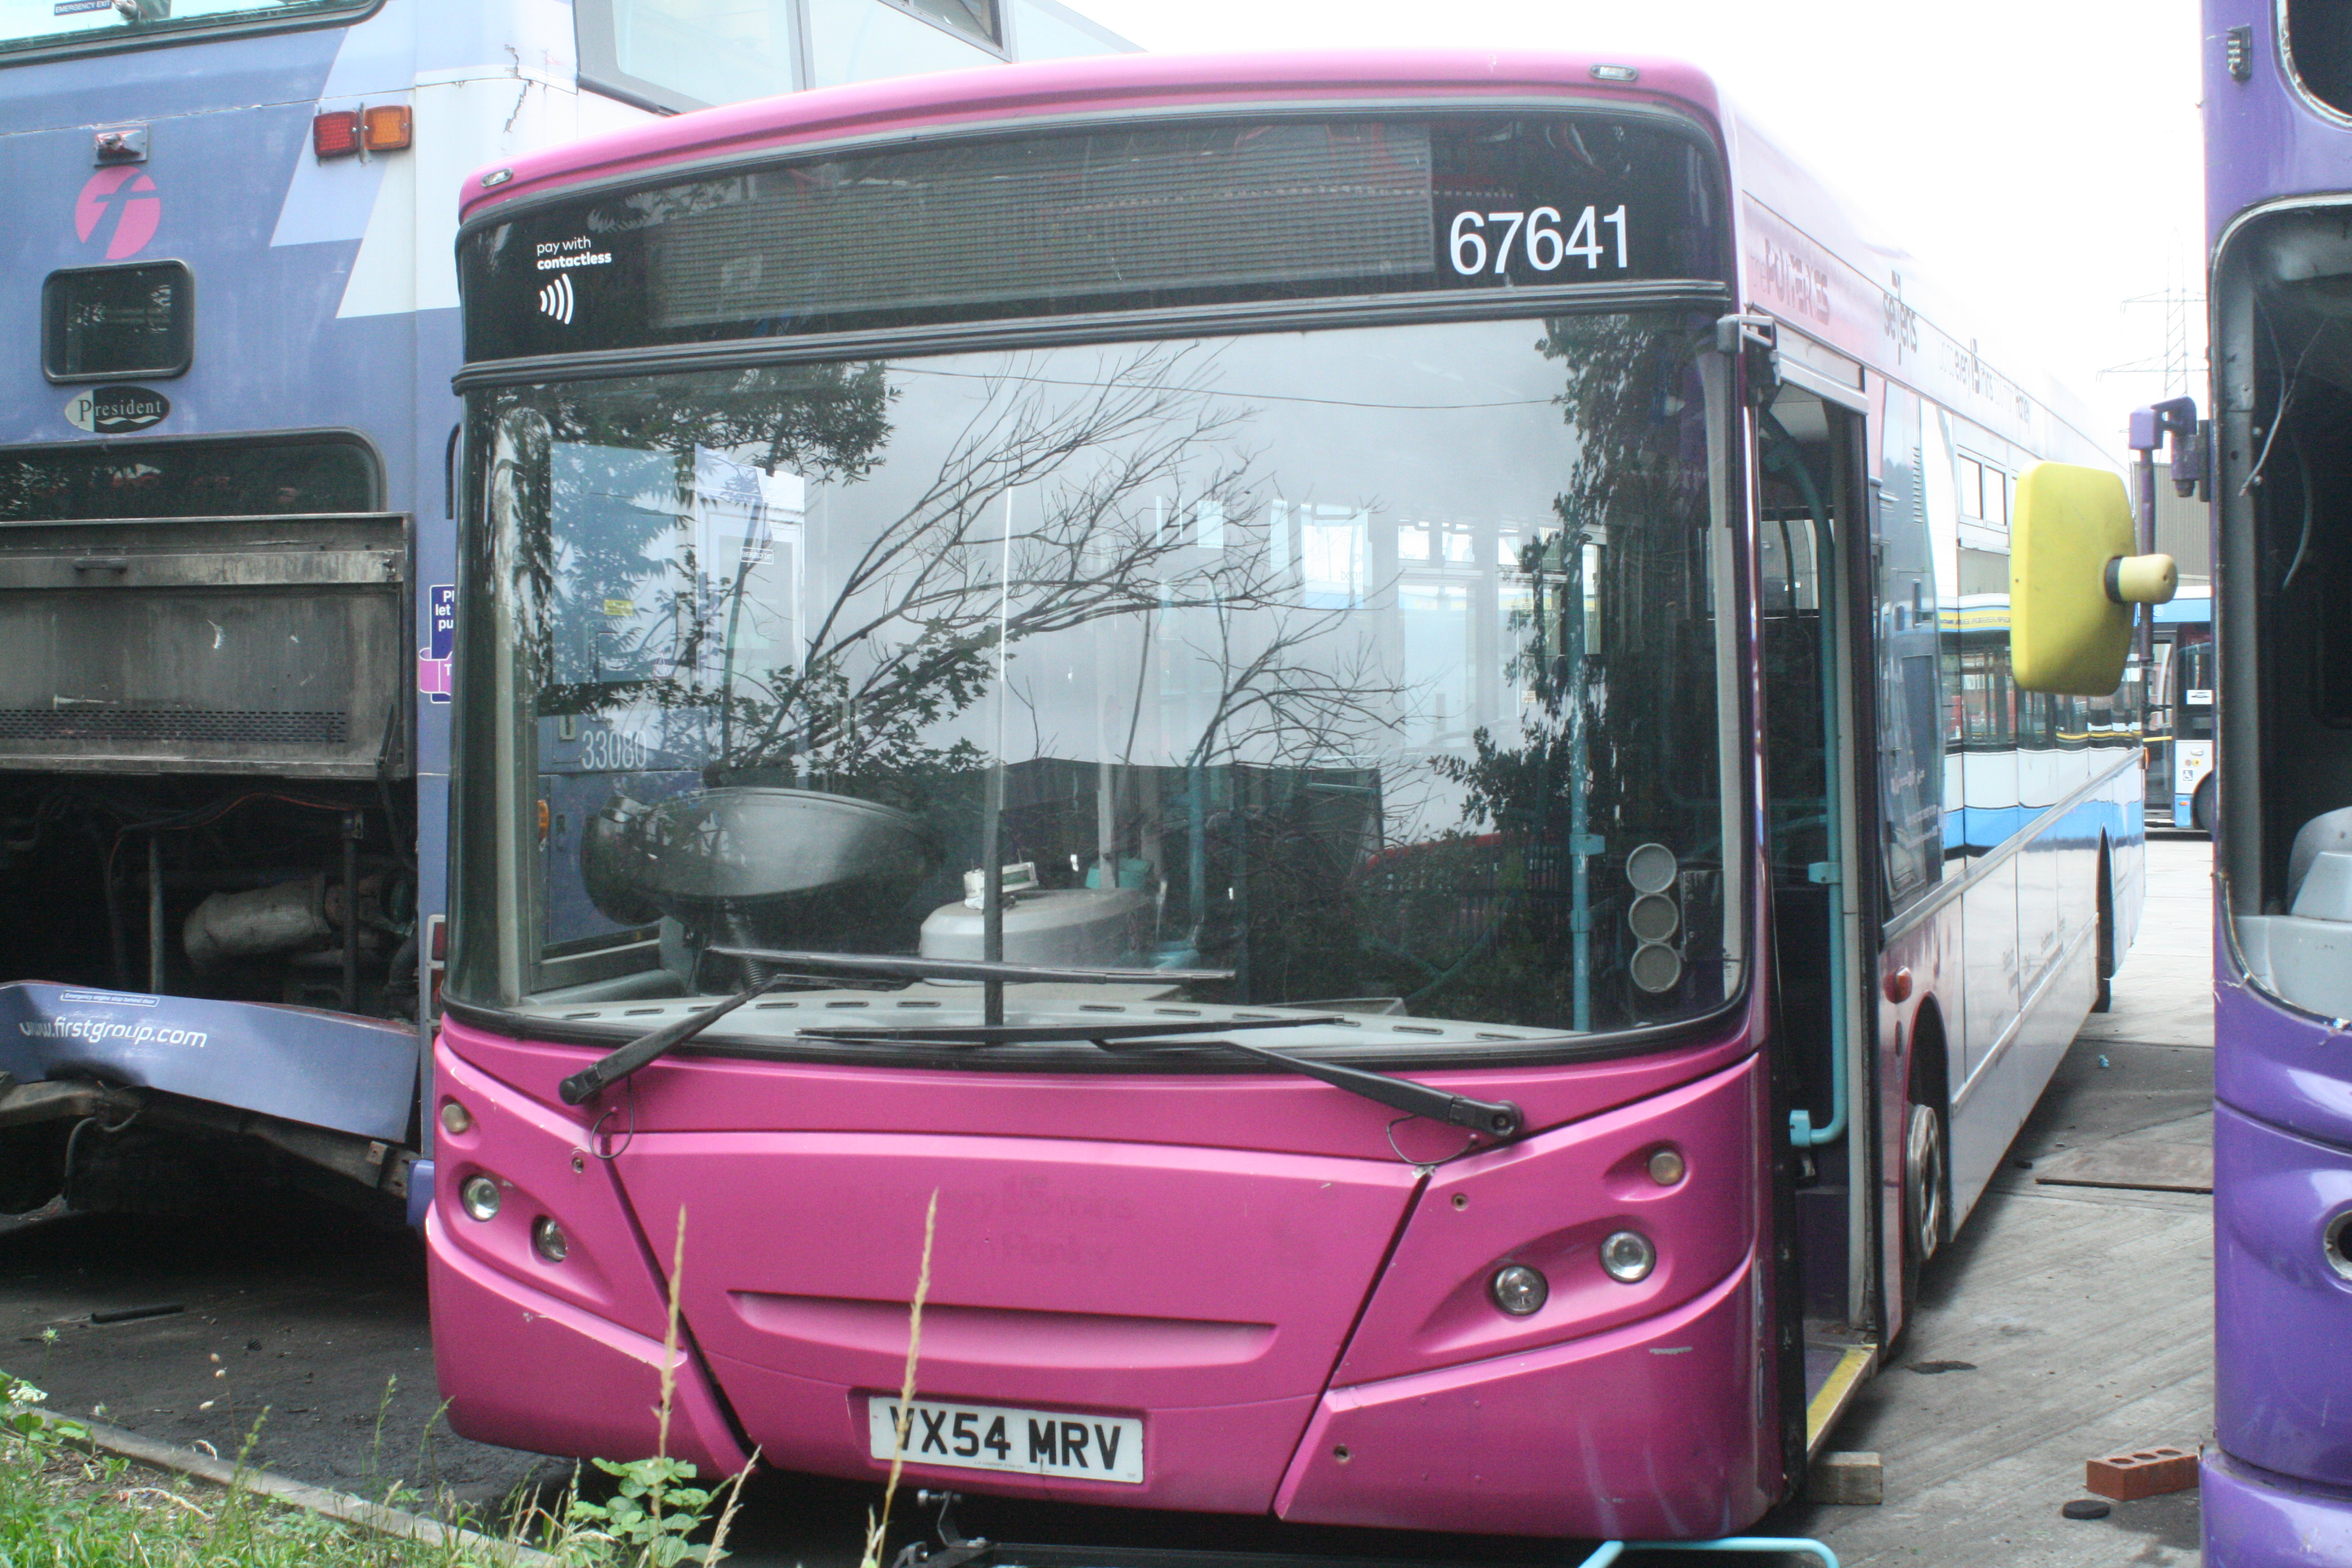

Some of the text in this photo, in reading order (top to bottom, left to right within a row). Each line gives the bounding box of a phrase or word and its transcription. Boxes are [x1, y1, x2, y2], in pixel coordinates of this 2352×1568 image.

[56, 2, 95, 13] EMERGENCY
[537, 235, 592, 256] pay with
[1450, 205, 1627, 275] 67641
[537, 252, 612, 270] contactless
[78, 399, 162, 422] President
[436, 604, 451, 616] let
[583, 730, 647, 769] 33080
[19, 1016, 208, 1047] www.firstgroup.com
[889, 1405, 1122, 1471] VX54 MRV
